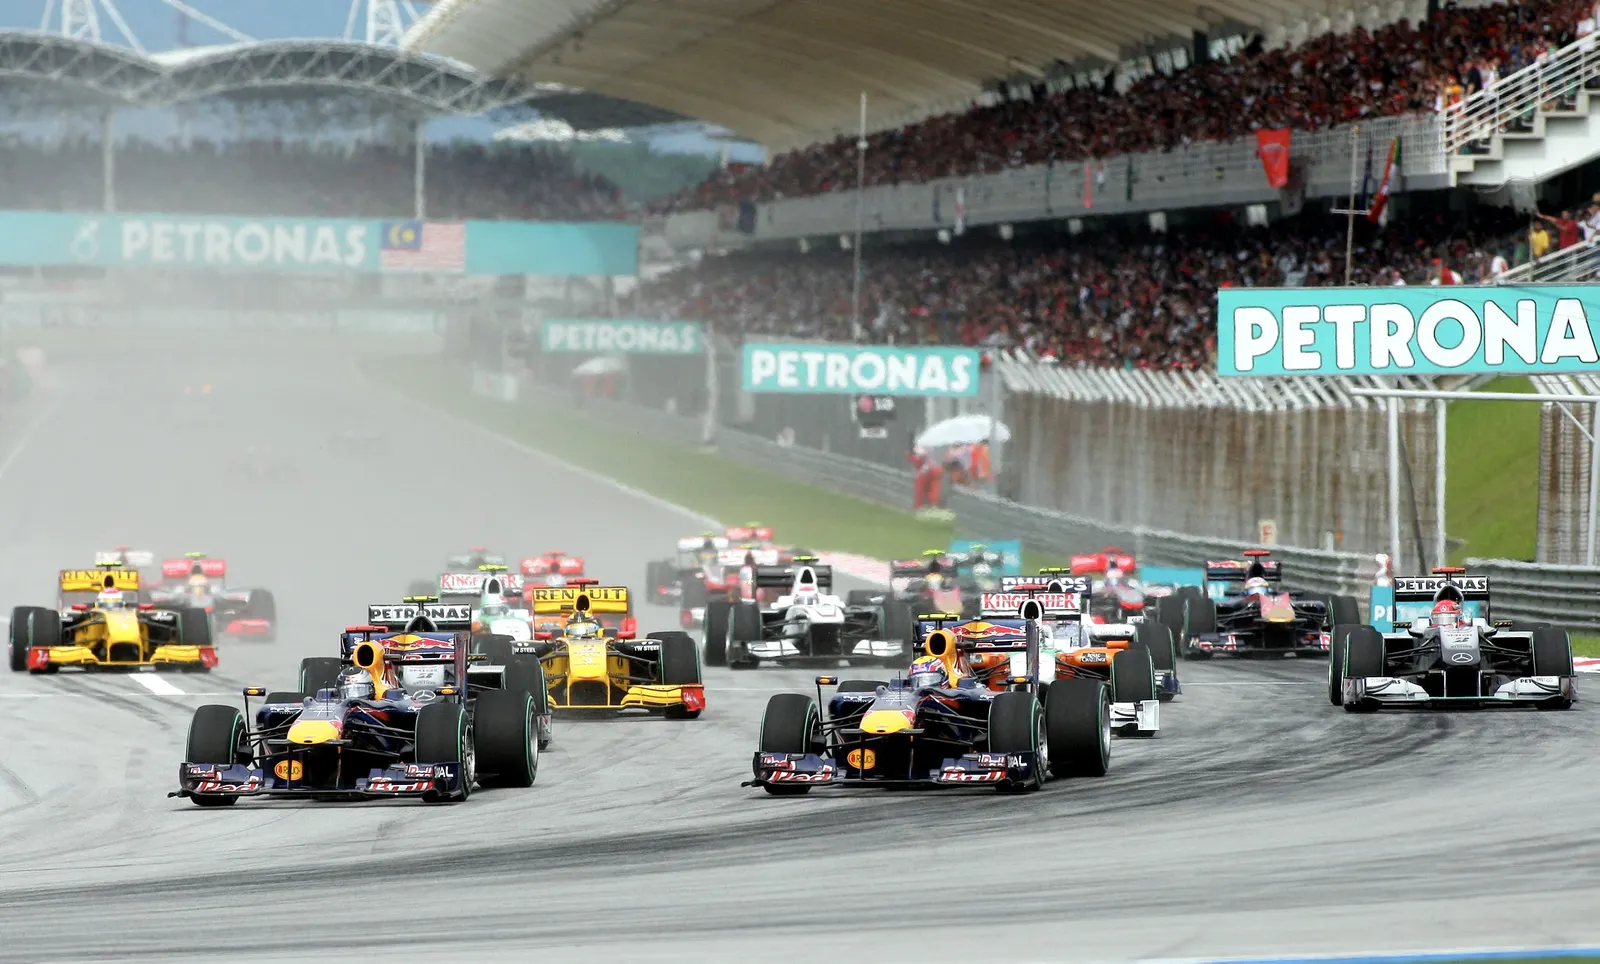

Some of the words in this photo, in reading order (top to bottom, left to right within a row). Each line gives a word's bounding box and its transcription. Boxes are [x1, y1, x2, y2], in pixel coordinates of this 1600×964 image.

[121, 220, 367, 266] PETRONAS
[547, 324, 697, 352] PETRONAS
[1233, 298, 1600, 373] PETRONA
[750, 349, 972, 391] PETRONAS
[535, 588, 625, 600] RENULT
[983, 592, 1075, 611] KINGSHER
